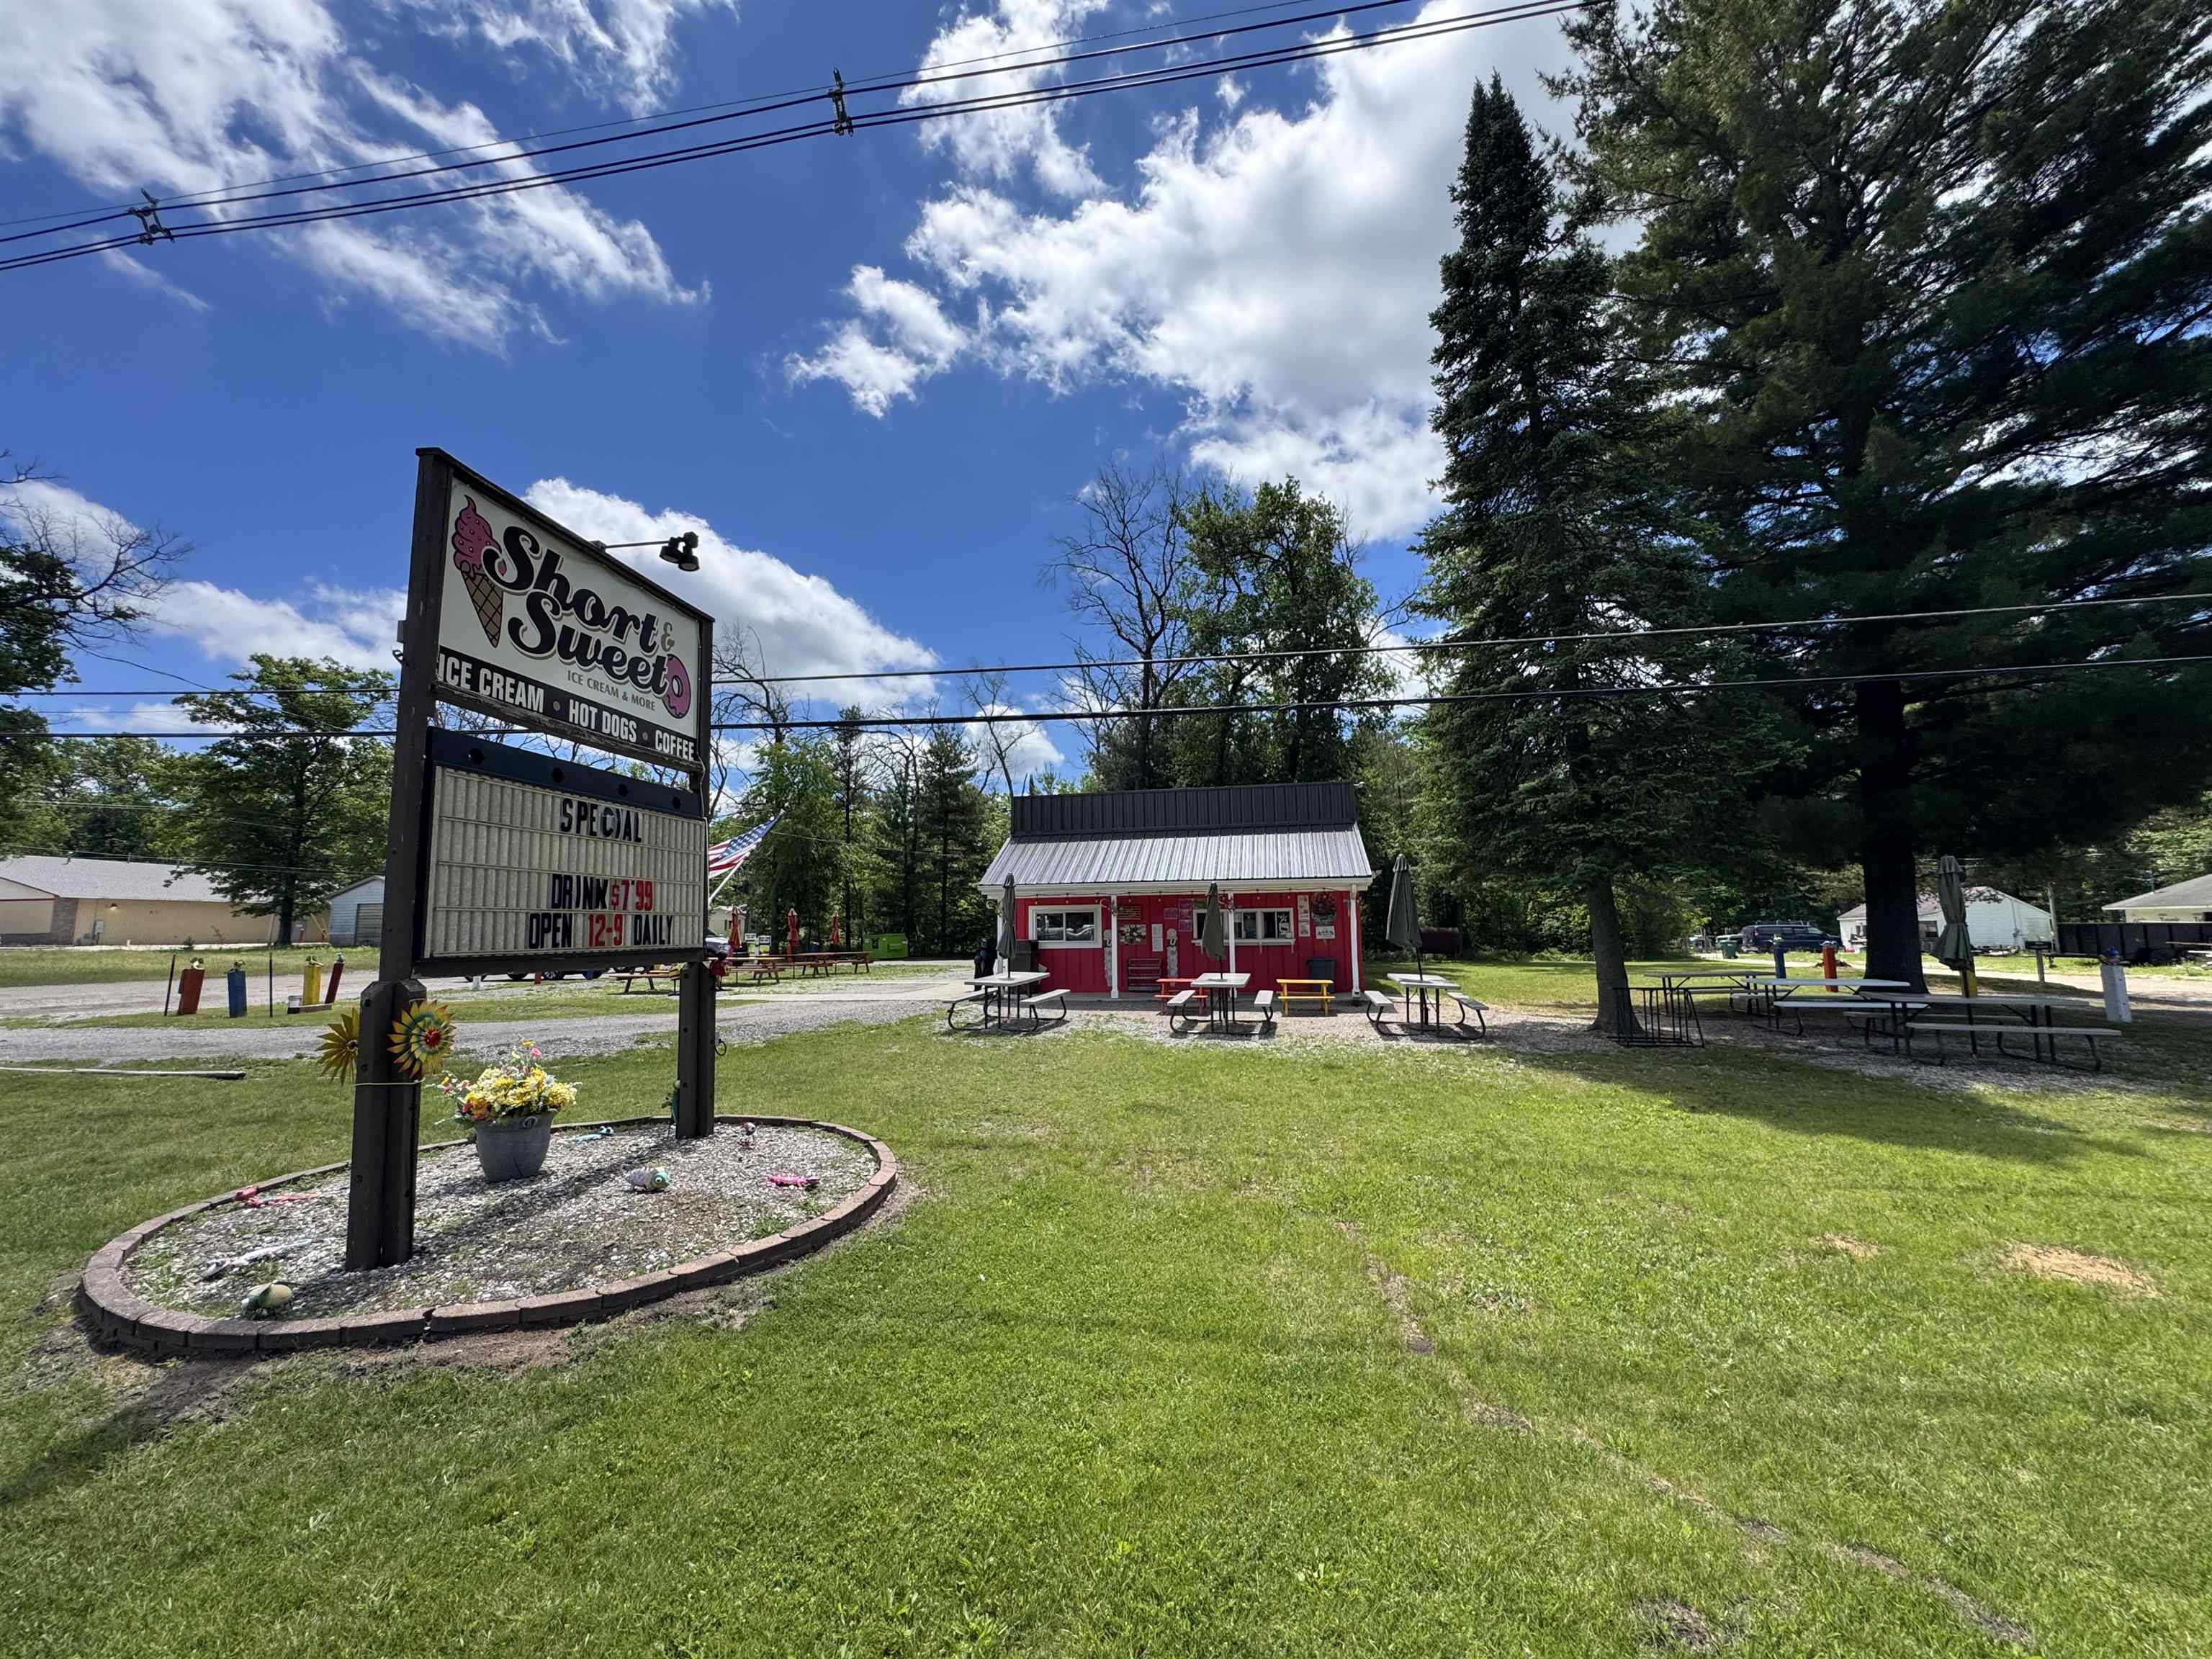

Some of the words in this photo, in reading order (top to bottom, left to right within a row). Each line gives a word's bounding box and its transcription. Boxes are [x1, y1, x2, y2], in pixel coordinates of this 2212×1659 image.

[482, 525, 657, 652] Short
[660, 622, 675, 652] &
[507, 592, 668, 694] Sweet
[438, 653, 472, 690] ICE
[479, 667, 544, 713] CREAM
[569, 699, 598, 729] HOT
[602, 711, 637, 742] DOGS
[655, 729, 694, 761] COFFEE
[567, 670, 583, 685] ICE
[587, 678, 619, 698] CREAM
[622, 691, 628, 701] &
[631, 694, 656, 711] MORE
[560, 798, 642, 842] SPECIAL
[551, 873, 608, 910] DRINK
[529, 912, 573, 949] OPEN
[588, 914, 623, 946] 12-9
[634, 914, 673, 945] DAILY
